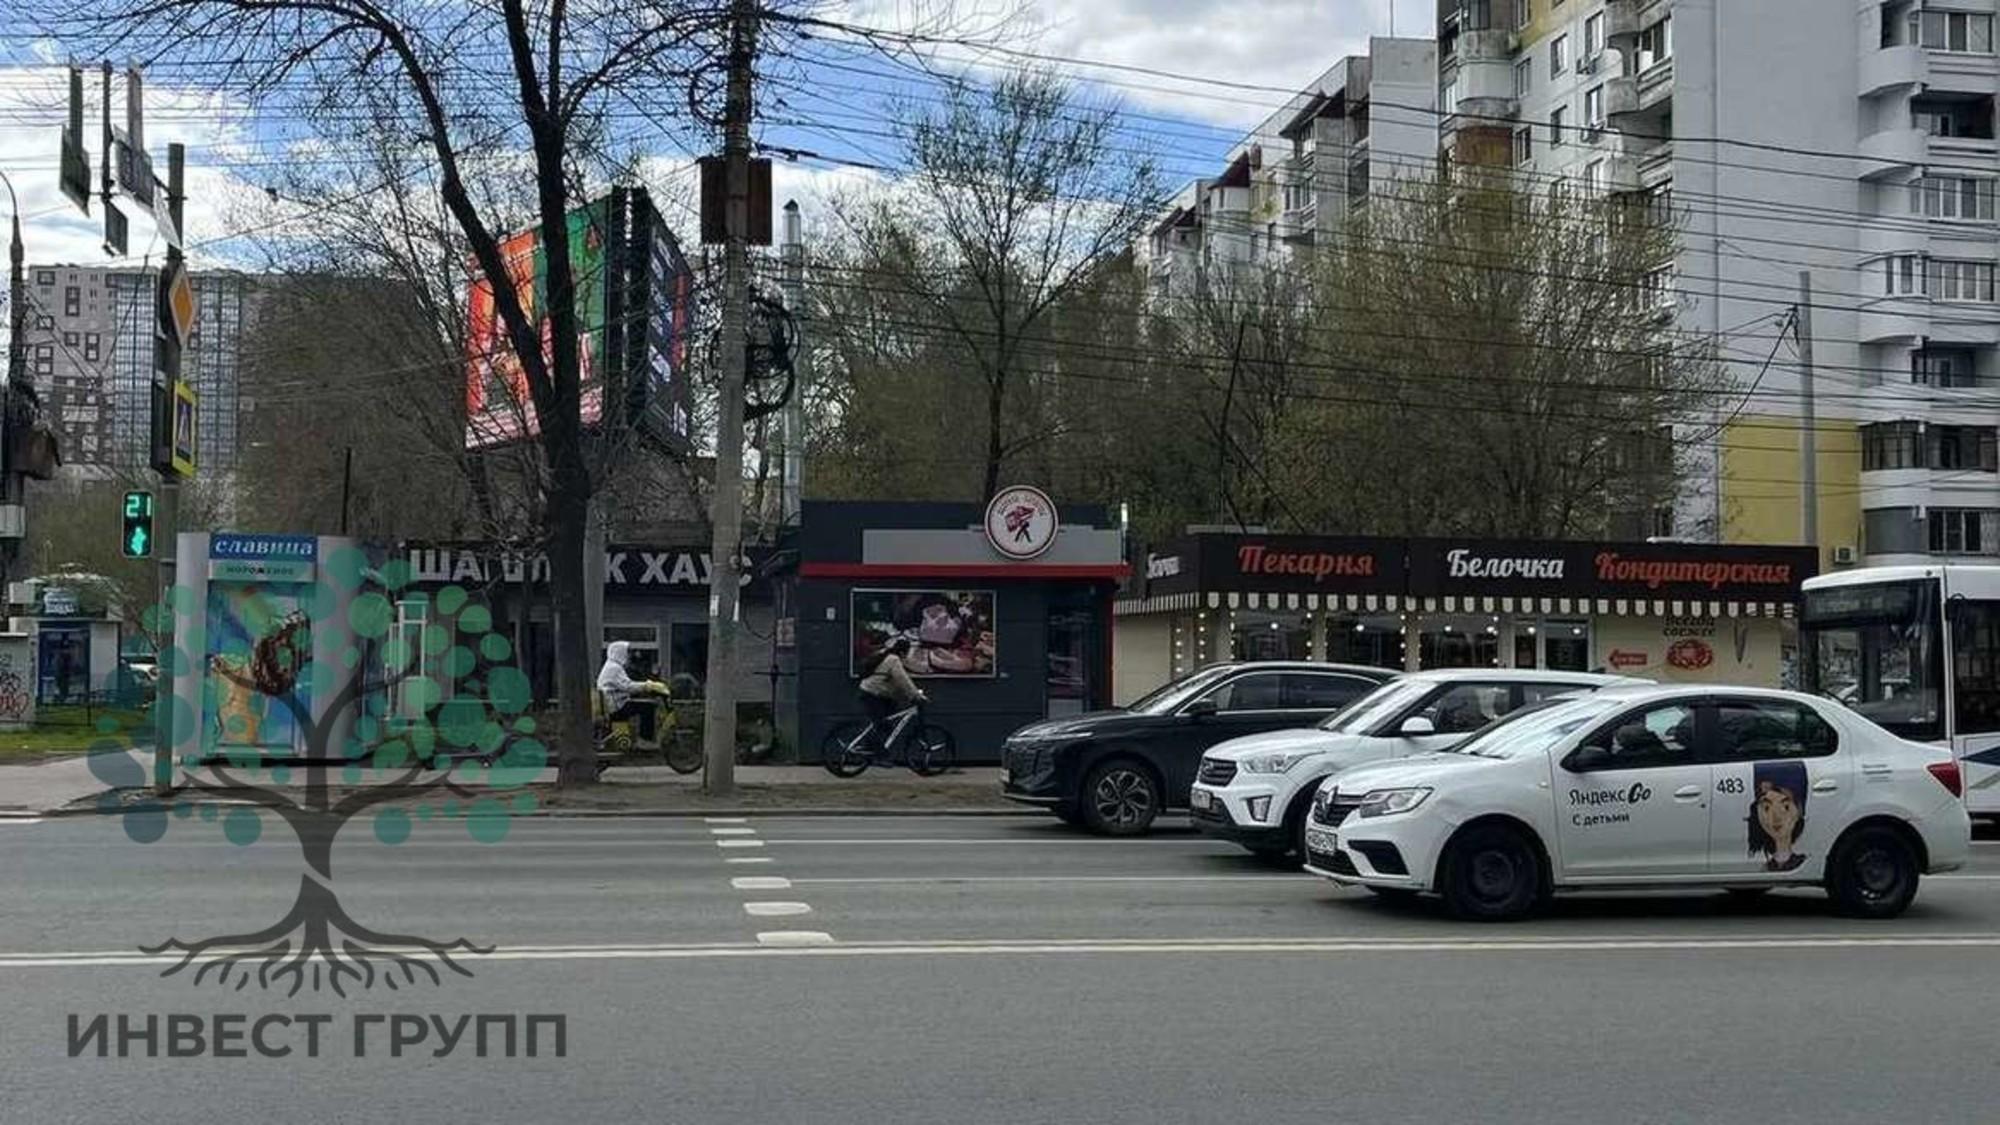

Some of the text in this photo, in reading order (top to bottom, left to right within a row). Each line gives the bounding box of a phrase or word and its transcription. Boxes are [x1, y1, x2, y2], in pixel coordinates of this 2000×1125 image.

[126, 494, 152, 518] 21
[1238, 545, 1374, 581] Пекарня
[1447, 549, 1791, 588] Белочка Кондитерская
[1716, 778, 1745, 794] 483
[1569, 788, 1626, 806] Яндекс
[1583, 813, 1630, 827] детьми
